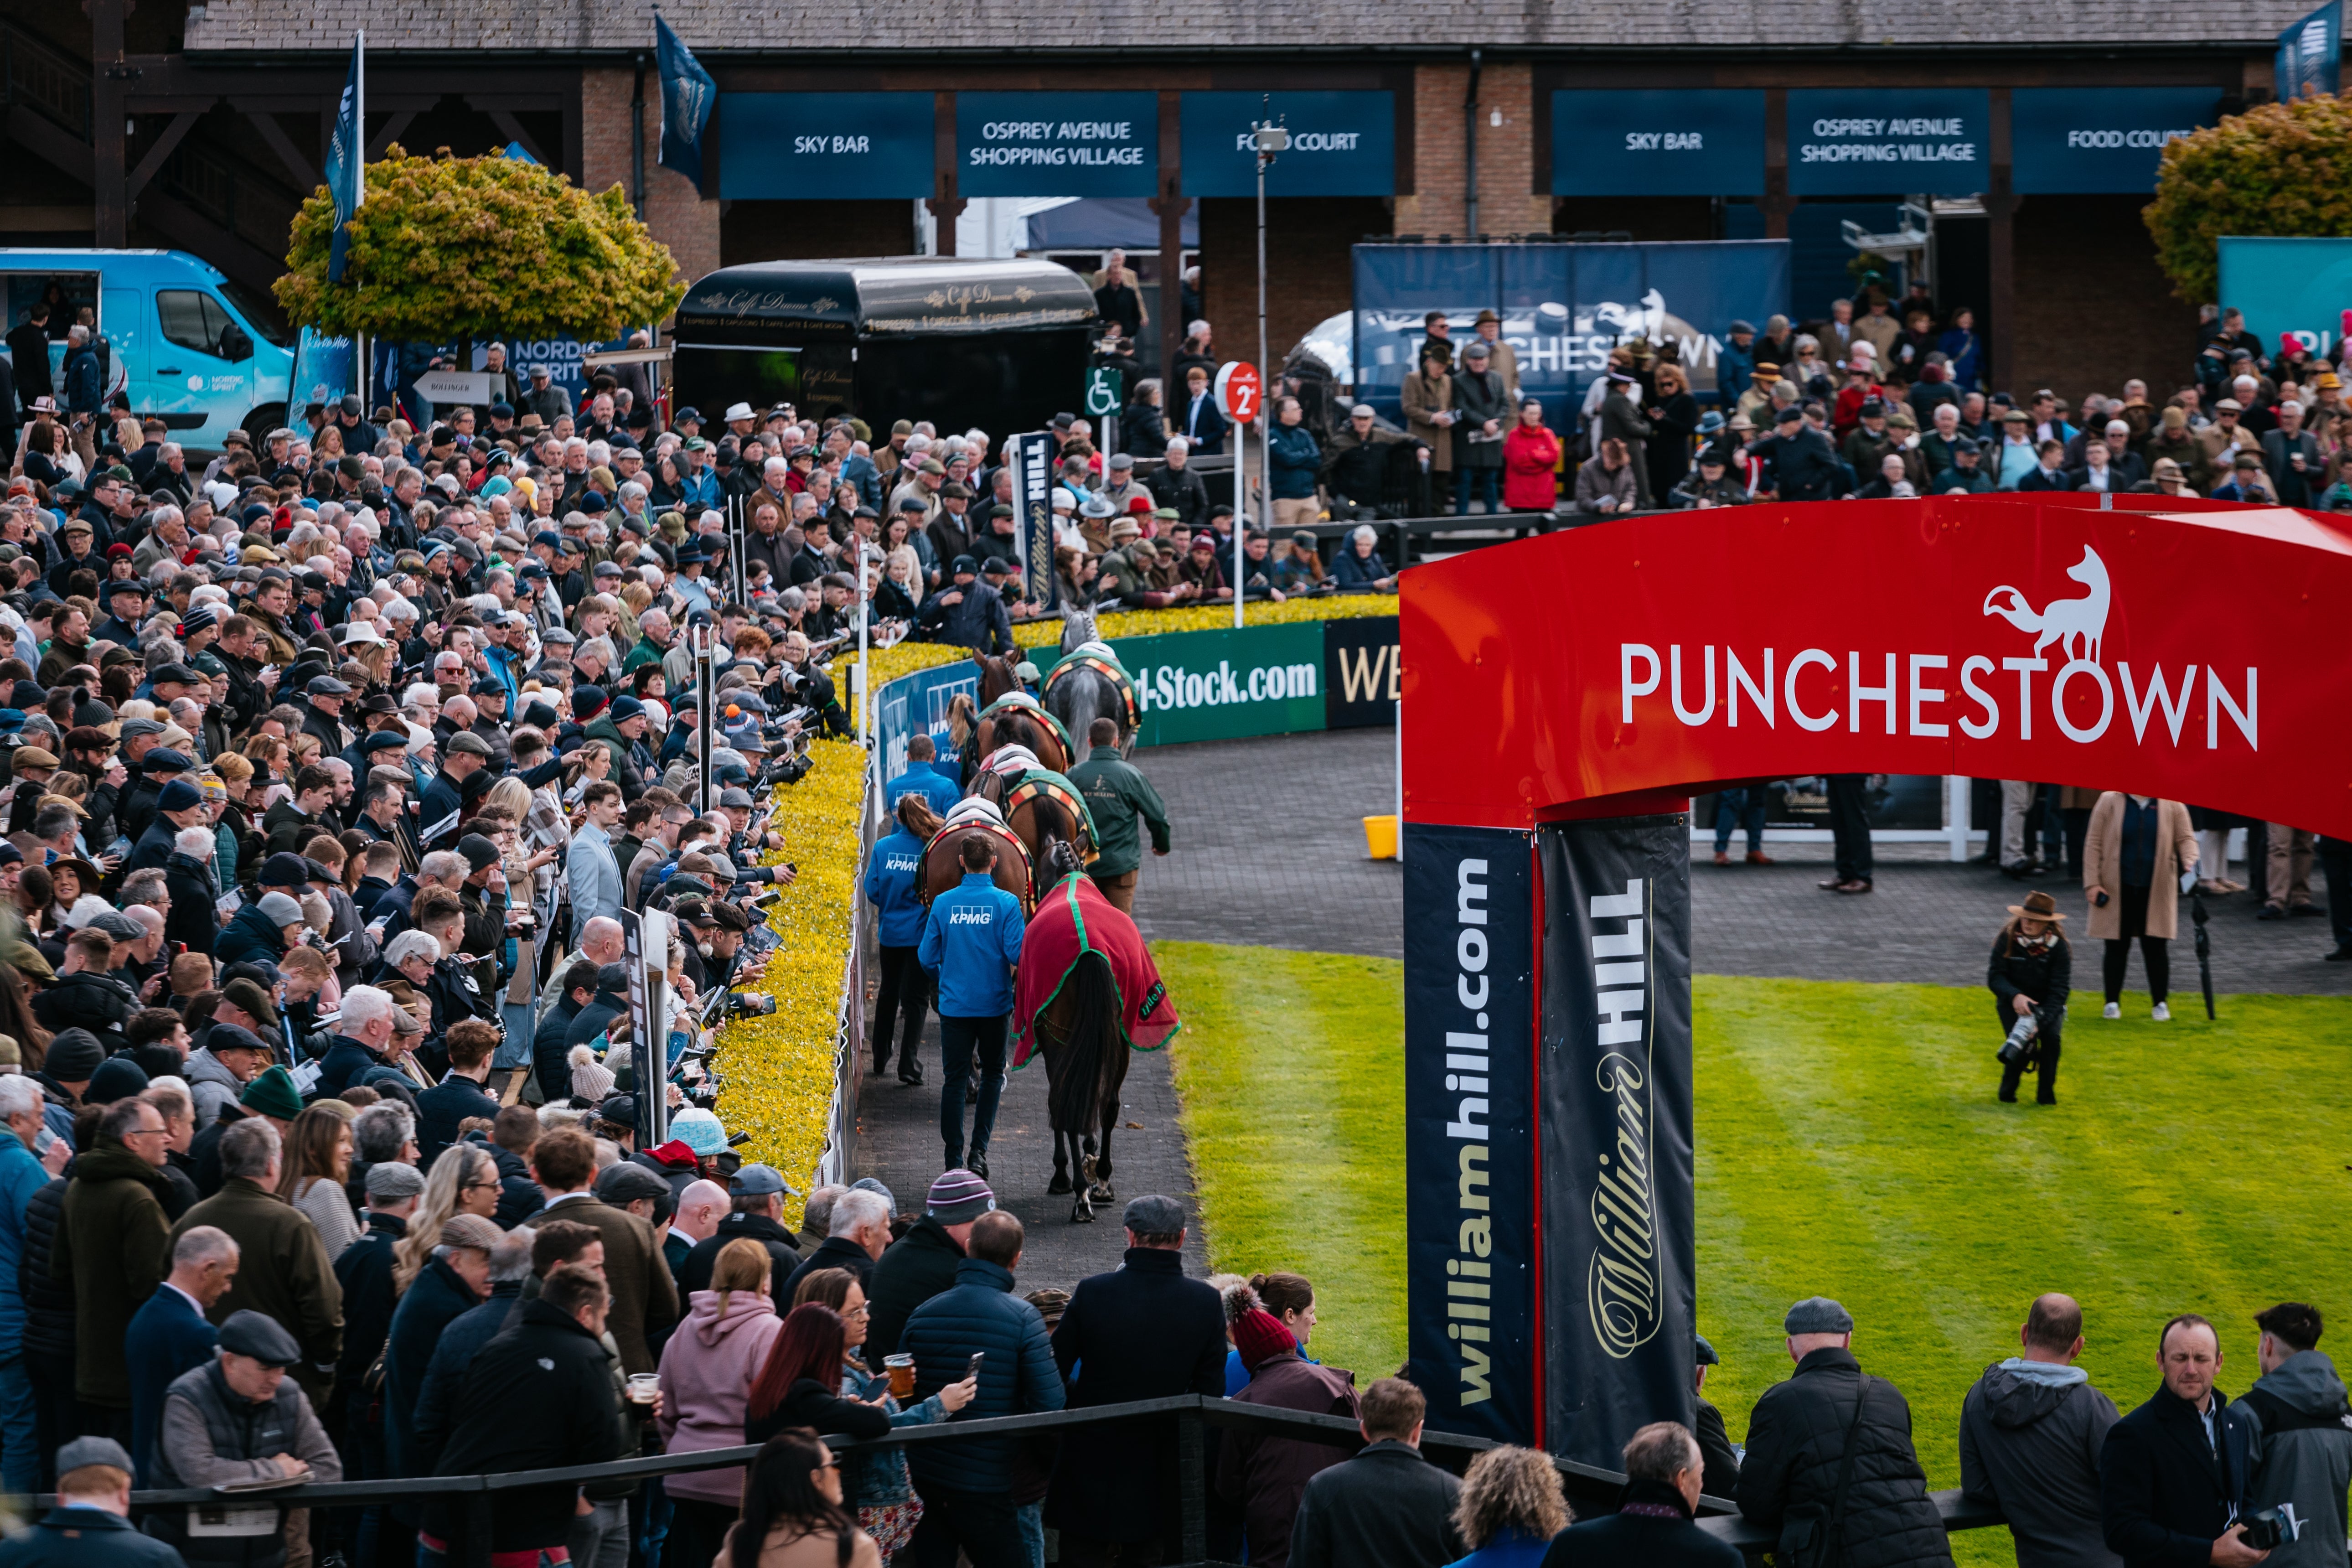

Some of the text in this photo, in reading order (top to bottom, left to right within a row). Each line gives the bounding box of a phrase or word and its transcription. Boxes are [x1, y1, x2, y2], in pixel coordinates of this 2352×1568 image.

[982, 122, 1132, 140] OSPREY AVENUE
[1813, 119, 1963, 136] OSPREY AVENUE
[795, 136, 869, 154] SKY BAR
[1295, 133, 1360, 151] COURT
[1625, 132, 1703, 150] SKY BAR
[2068, 130, 2125, 148] FOOD
[970, 147, 1144, 166] SHOPPING VILLAGE
[1800, 144, 1976, 162] SHOPPING VILLAGE
[431, 383, 470, 393] BOLLINGER
[1027, 439, 1045, 501] HILL
[1029, 501, 1051, 612] William
[1621, 644, 2258, 752] PUNCHESTOWN
[949, 913, 991, 925] KPMG
[1591, 878, 1644, 1045] HILL
[627, 928, 644, 1046] HILL
[1447, 858, 1491, 1407] williamhill.com
[1588, 1050, 1663, 1359] William
